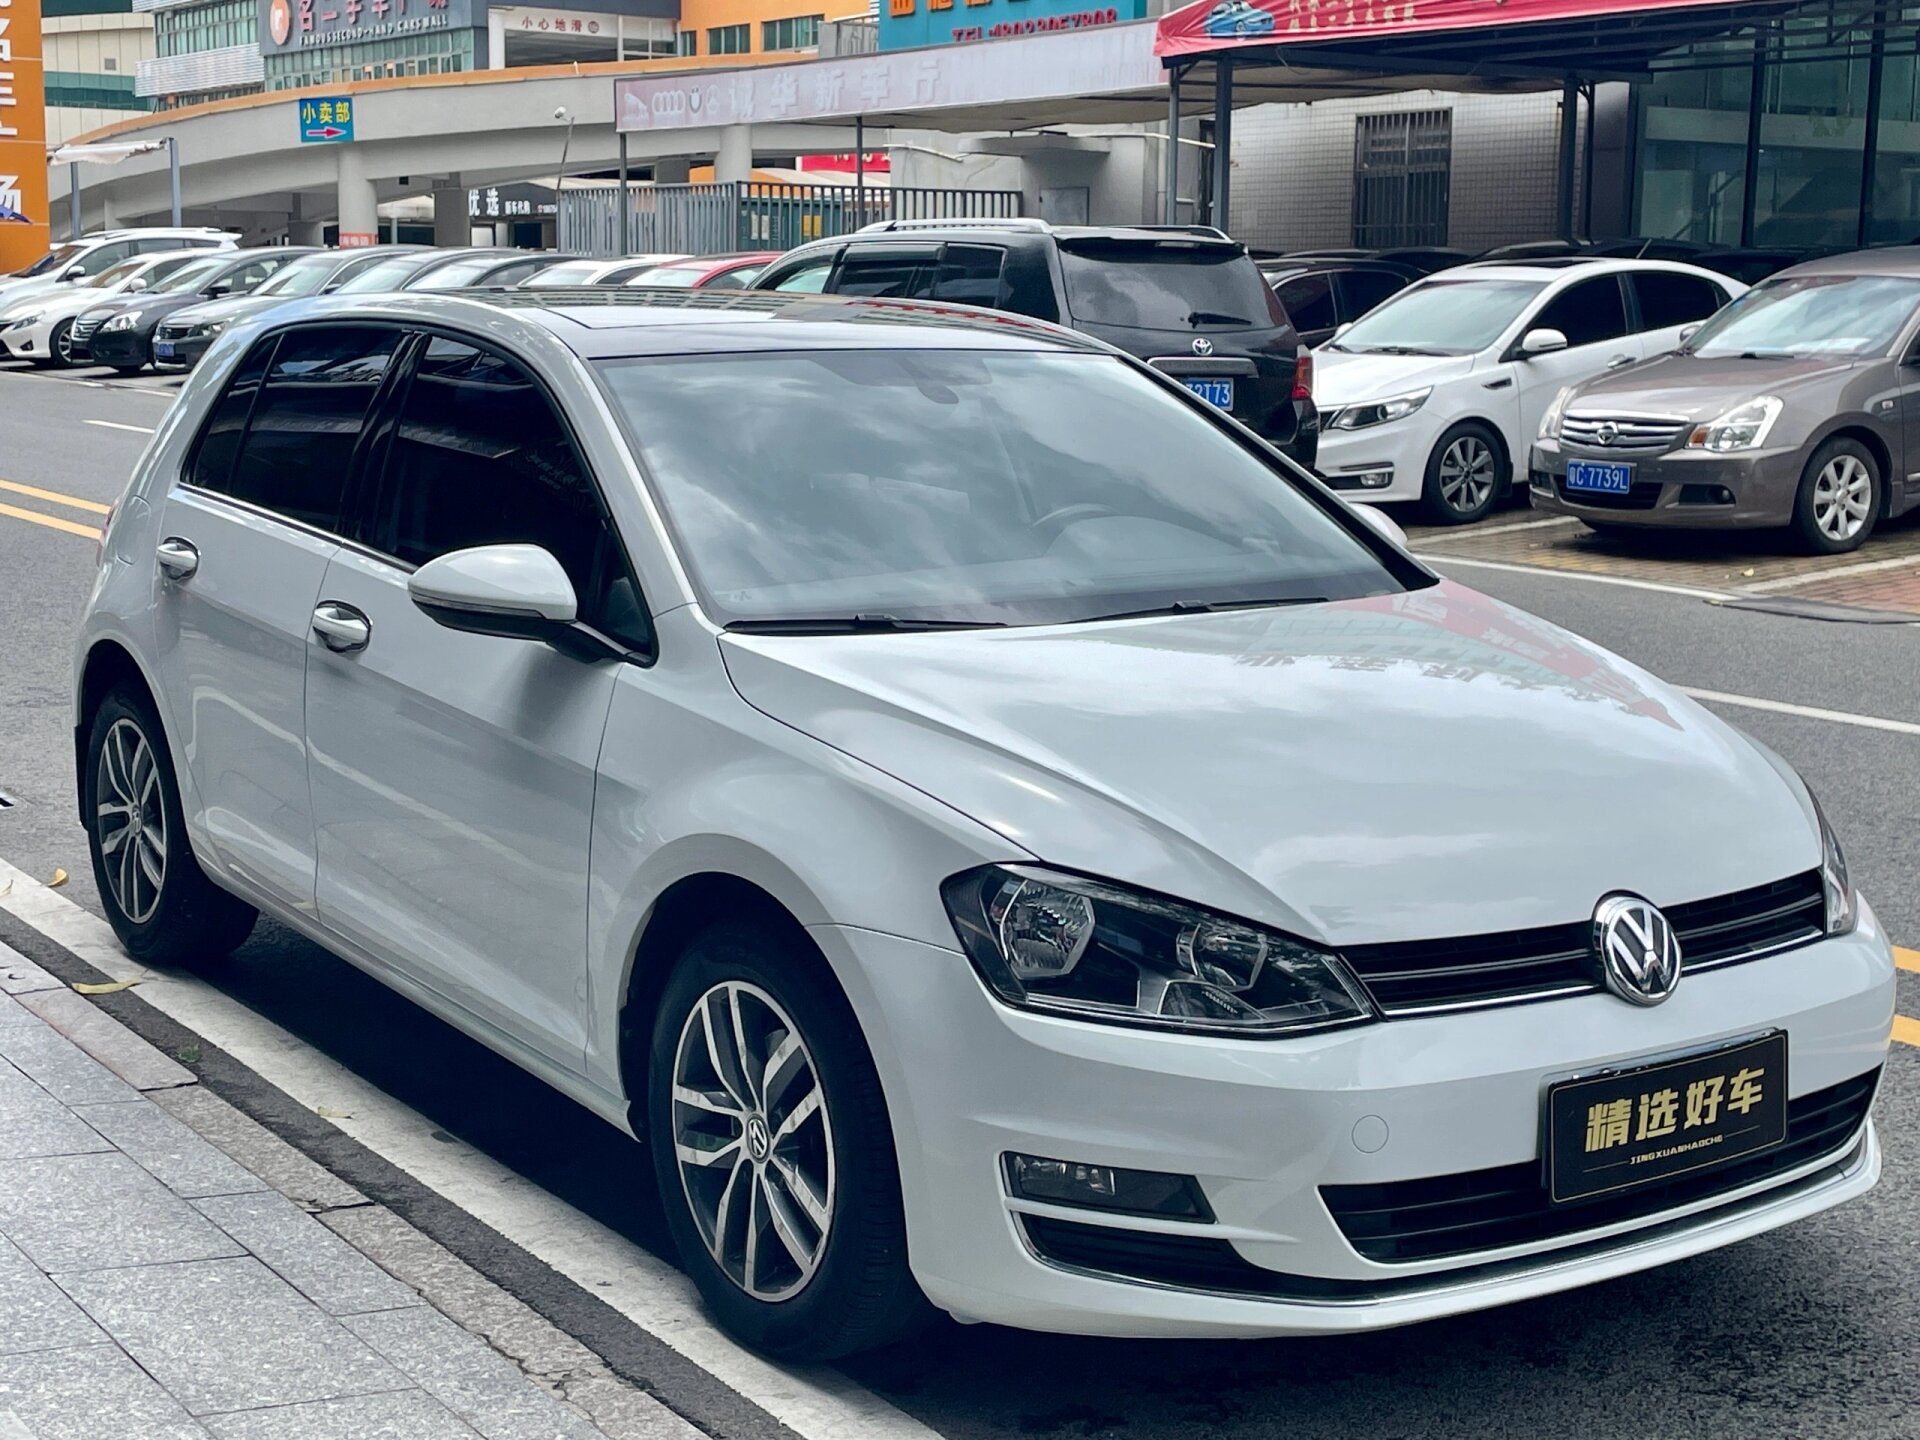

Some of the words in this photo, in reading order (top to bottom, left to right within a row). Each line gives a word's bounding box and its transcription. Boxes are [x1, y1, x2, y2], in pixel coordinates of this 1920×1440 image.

[521, 16, 583, 33] 小心地滑
[303, 101, 350, 124] 小卖部
[468, 187, 500, 216] 优选
[1584, 1067, 1766, 1153] 精选好车
[1629, 1134, 1723, 1165] JINGXUANHAOCHE
